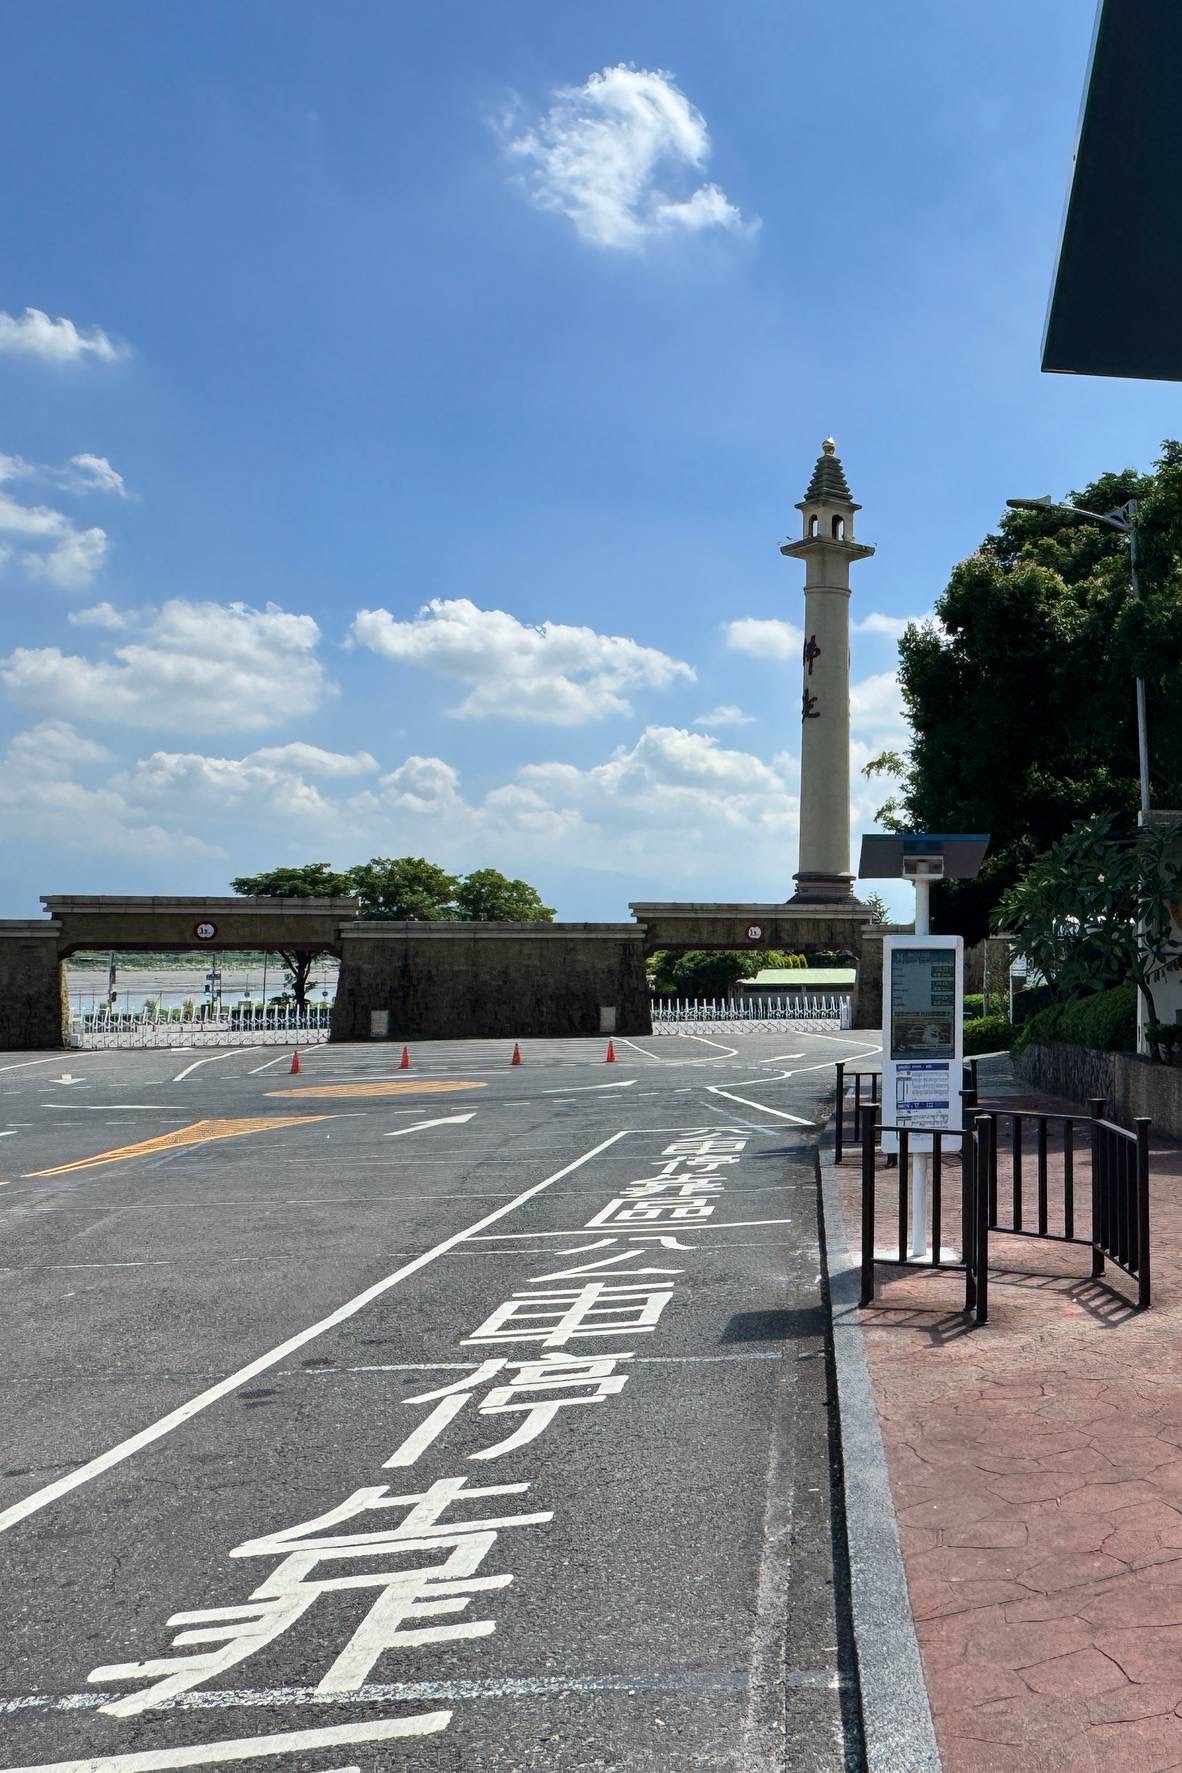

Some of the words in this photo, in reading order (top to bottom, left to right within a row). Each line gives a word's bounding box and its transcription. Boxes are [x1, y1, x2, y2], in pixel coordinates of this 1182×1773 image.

[584, 1128, 752, 1228] 公車停靠區
